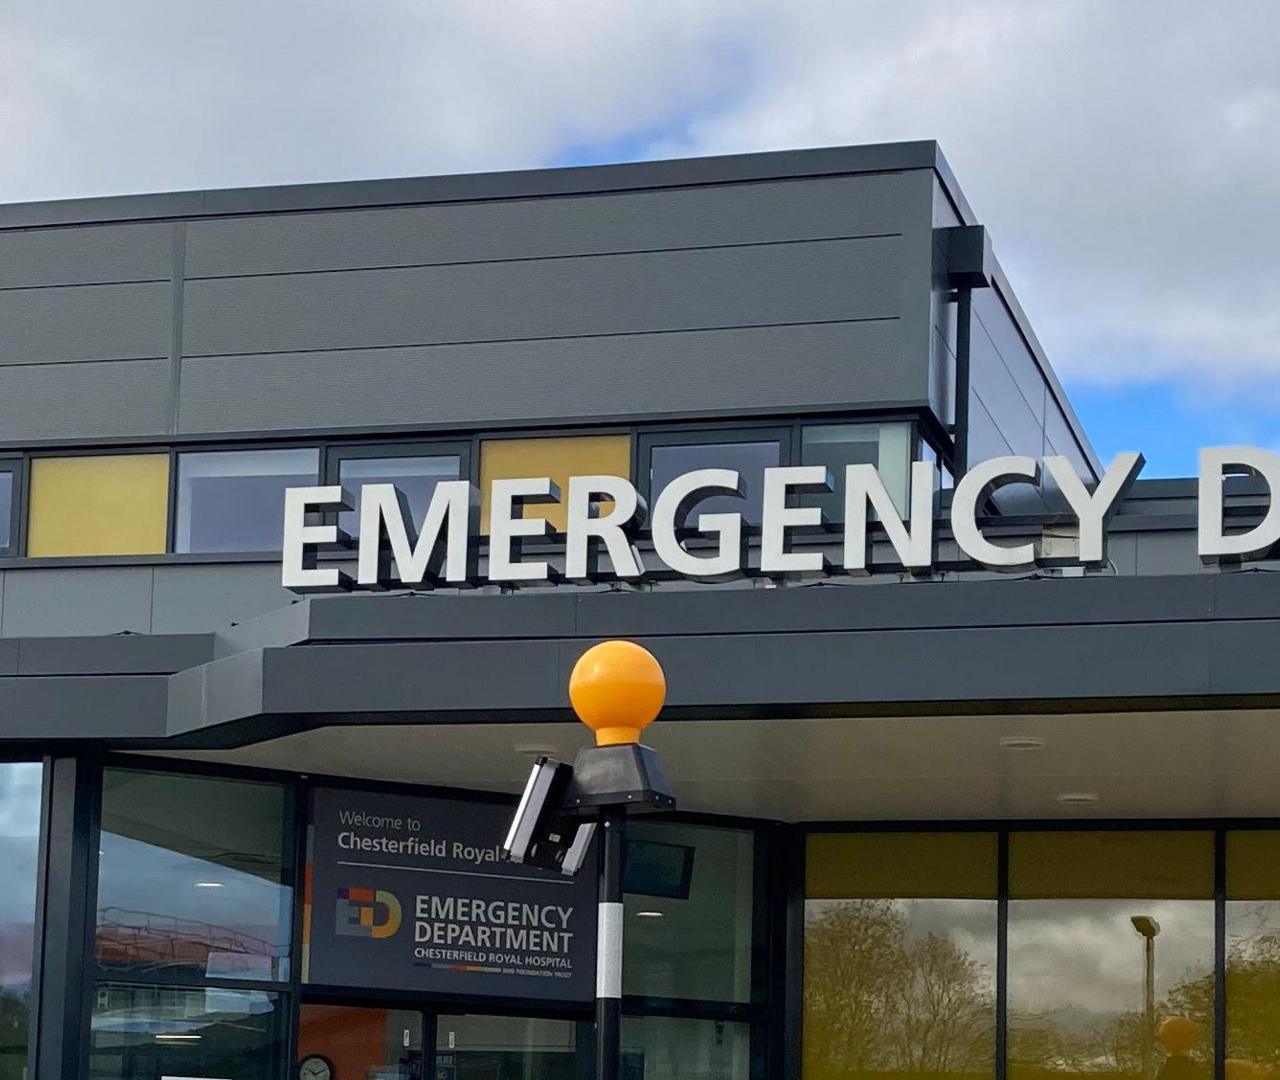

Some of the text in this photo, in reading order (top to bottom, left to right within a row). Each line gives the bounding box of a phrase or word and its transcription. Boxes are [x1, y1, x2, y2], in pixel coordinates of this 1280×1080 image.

[282, 452, 1147, 590] EMERGENCY
[339, 810, 422, 832] Welcome to
[337, 832, 500, 865] Chesterfield Royal
[415, 895, 574, 929] EMERGENCY
[414, 921, 574, 953] DEPARTMENT
[414, 947, 572, 968] CHESTERFIELD ROYAL HOSPITAL
